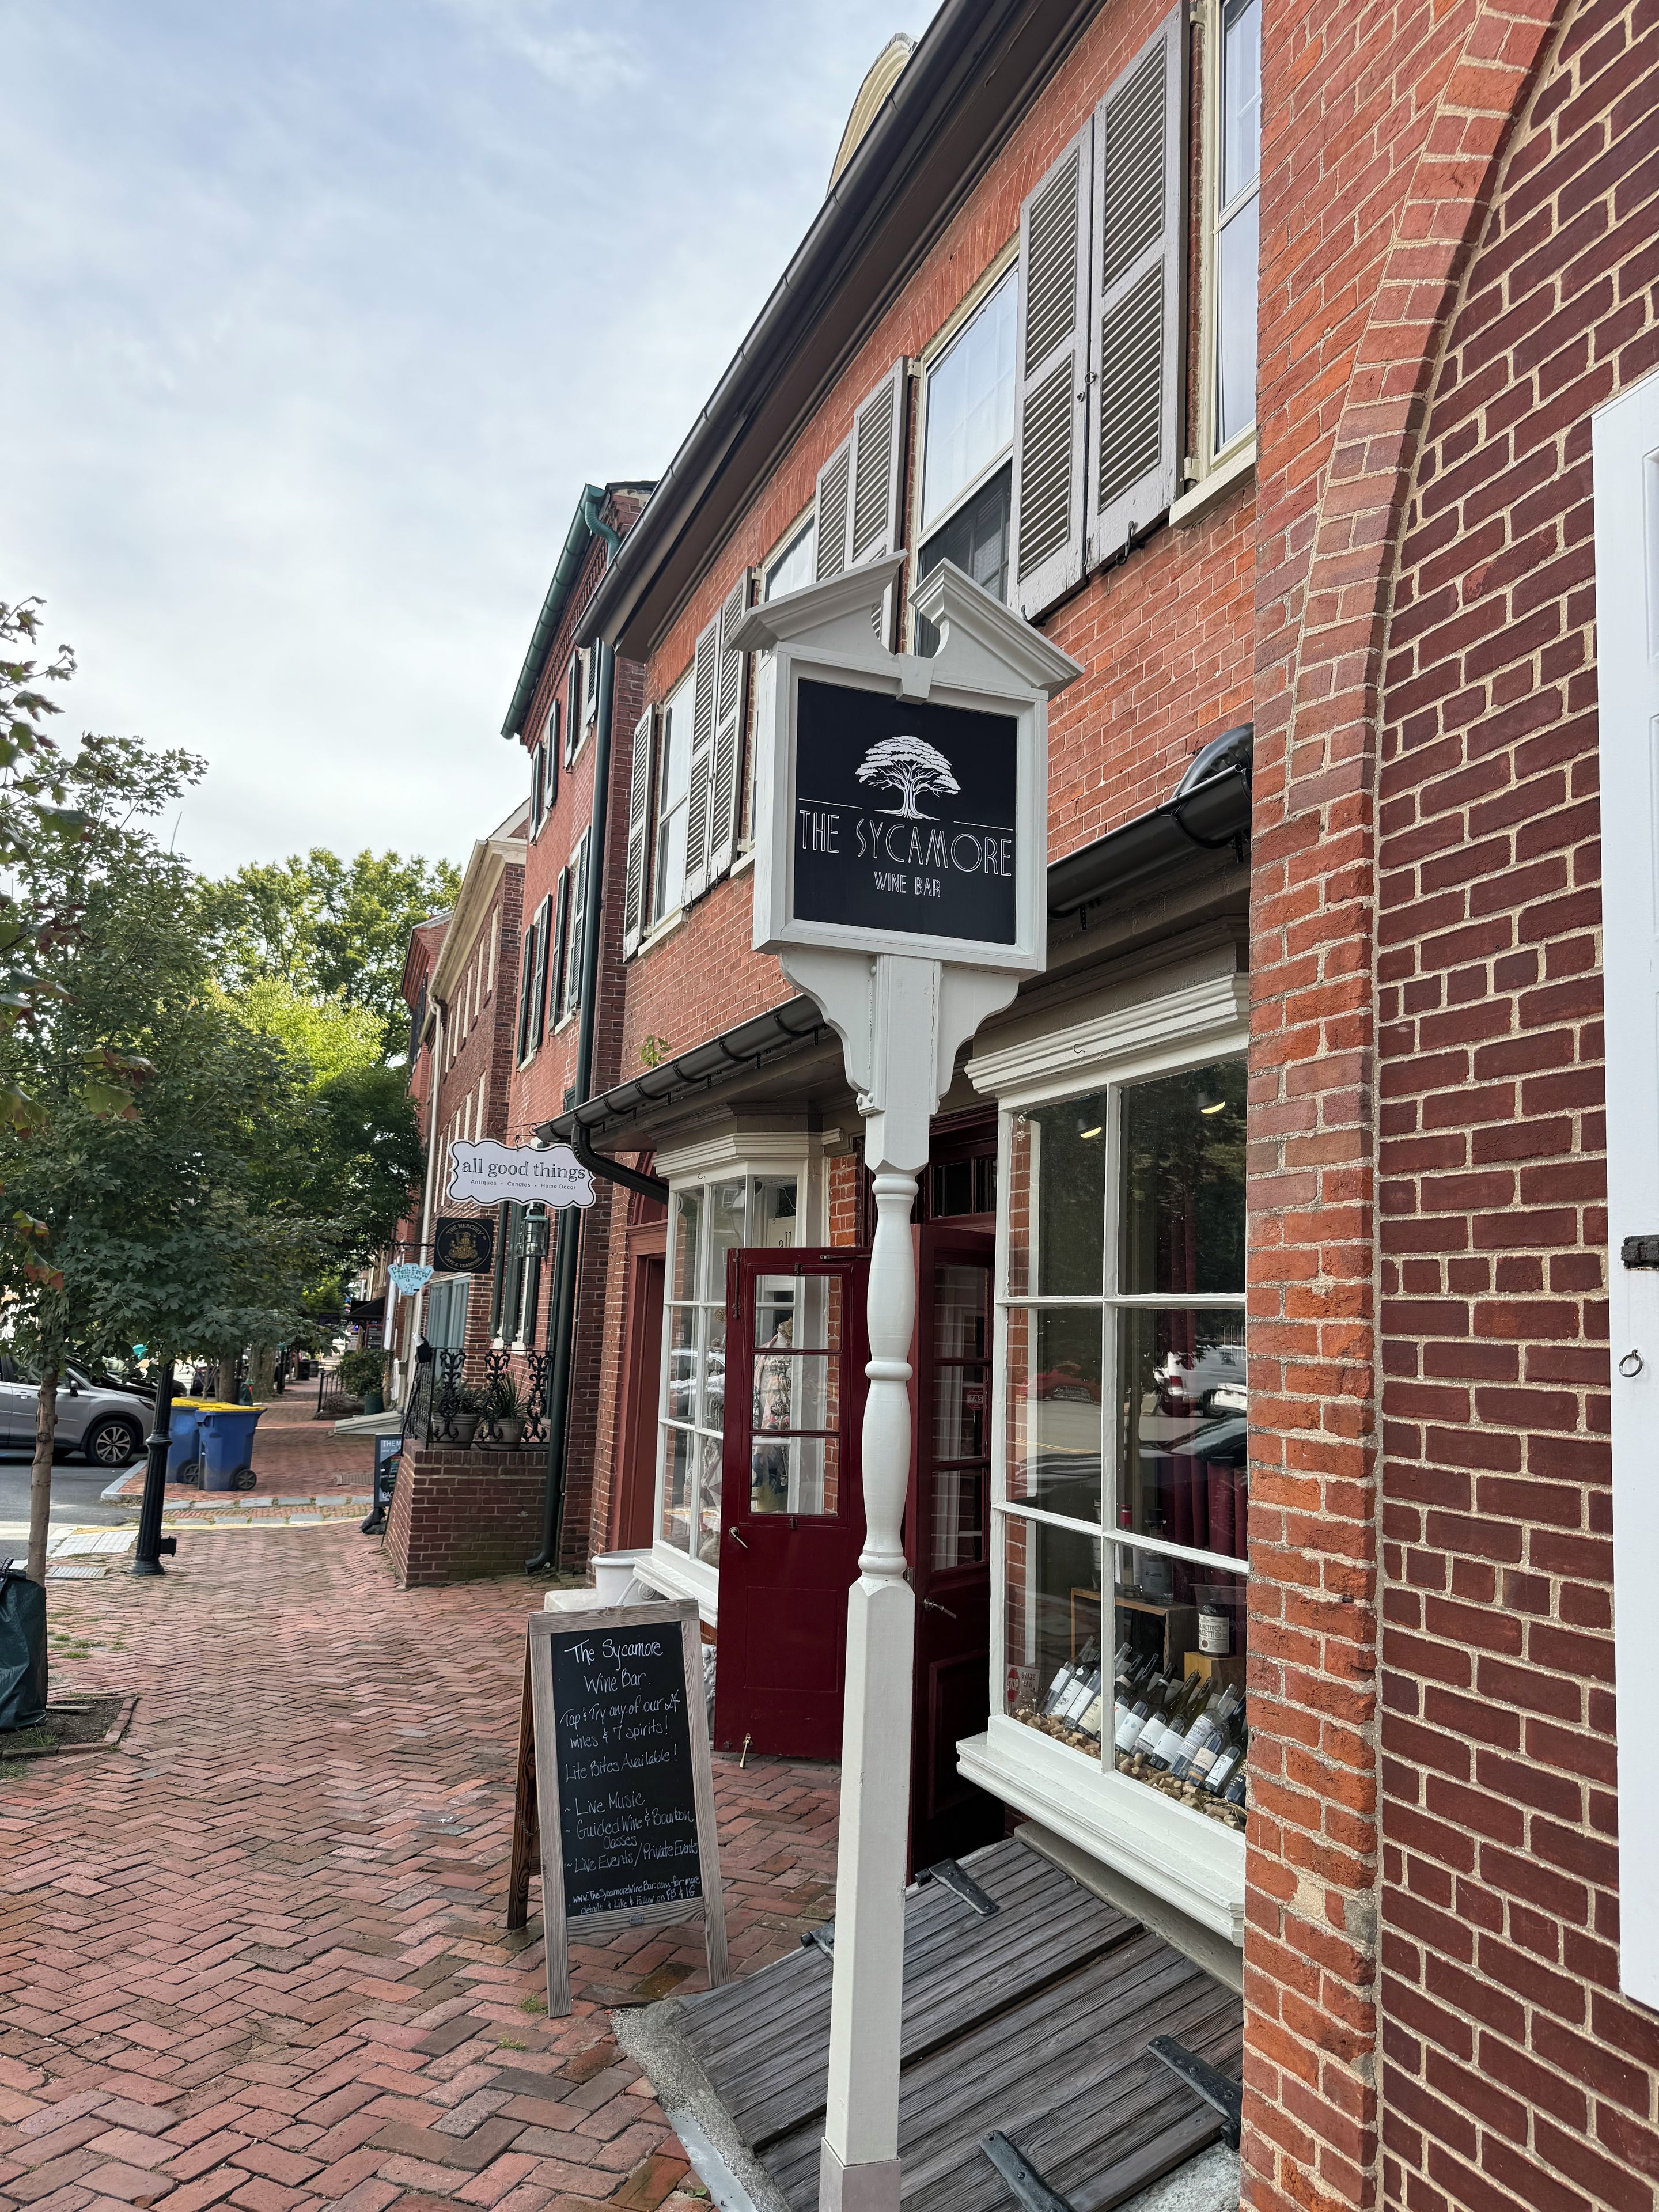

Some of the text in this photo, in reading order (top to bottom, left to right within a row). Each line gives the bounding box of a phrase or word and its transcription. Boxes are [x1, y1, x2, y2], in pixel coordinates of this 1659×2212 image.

[799, 810, 1012, 877] THE SYCAMORE
[874, 871, 941, 898] WINE BAR
[461, 1158, 586, 1183] all good things
[445, 1223, 484, 1235] THE MERCURY
[391, 1266, 432, 1279] Fresh Faced
[564, 1638, 664, 1671] The Sycamore
[584, 1672, 618, 1694] Wine
[1007, 1677, 1019, 1691] STOP
[1021, 1672, 1036, 1681] STATE
[560, 1708, 581, 1730] Tap
[589, 1703, 607, 1725] Try
[609, 1704, 627, 1724] any
[628, 1695, 642, 1715] of
[643, 1698, 664, 1713] our
[665, 1689, 680, 1713] 24
[570, 1714, 668, 1749] wines & 7 spirits!
[566, 1761, 588, 1783] Lite
[589, 1755, 620, 1777] Bites
[575, 1791, 646, 1816] Live Music
[576, 1817, 620, 1839] Guided
[621, 1814, 642, 1832] Wine
[652, 1806, 694, 1825] Bourbon
[603, 1835, 638, 1850] Classes
[574, 1857, 597, 1873] Live
[643, 1840, 673, 1860] Private
[674, 1839, 698, 1856] Events
[672, 1874, 685, 1887] for
[685, 1876, 701, 1885] more
[581, 1903, 604, 1915] details
[614, 1898, 628, 1908] Like
[636, 1895, 655, 1905] Follow
[666, 1888, 676, 1900] FB
[686, 1885, 696, 1897] IG
